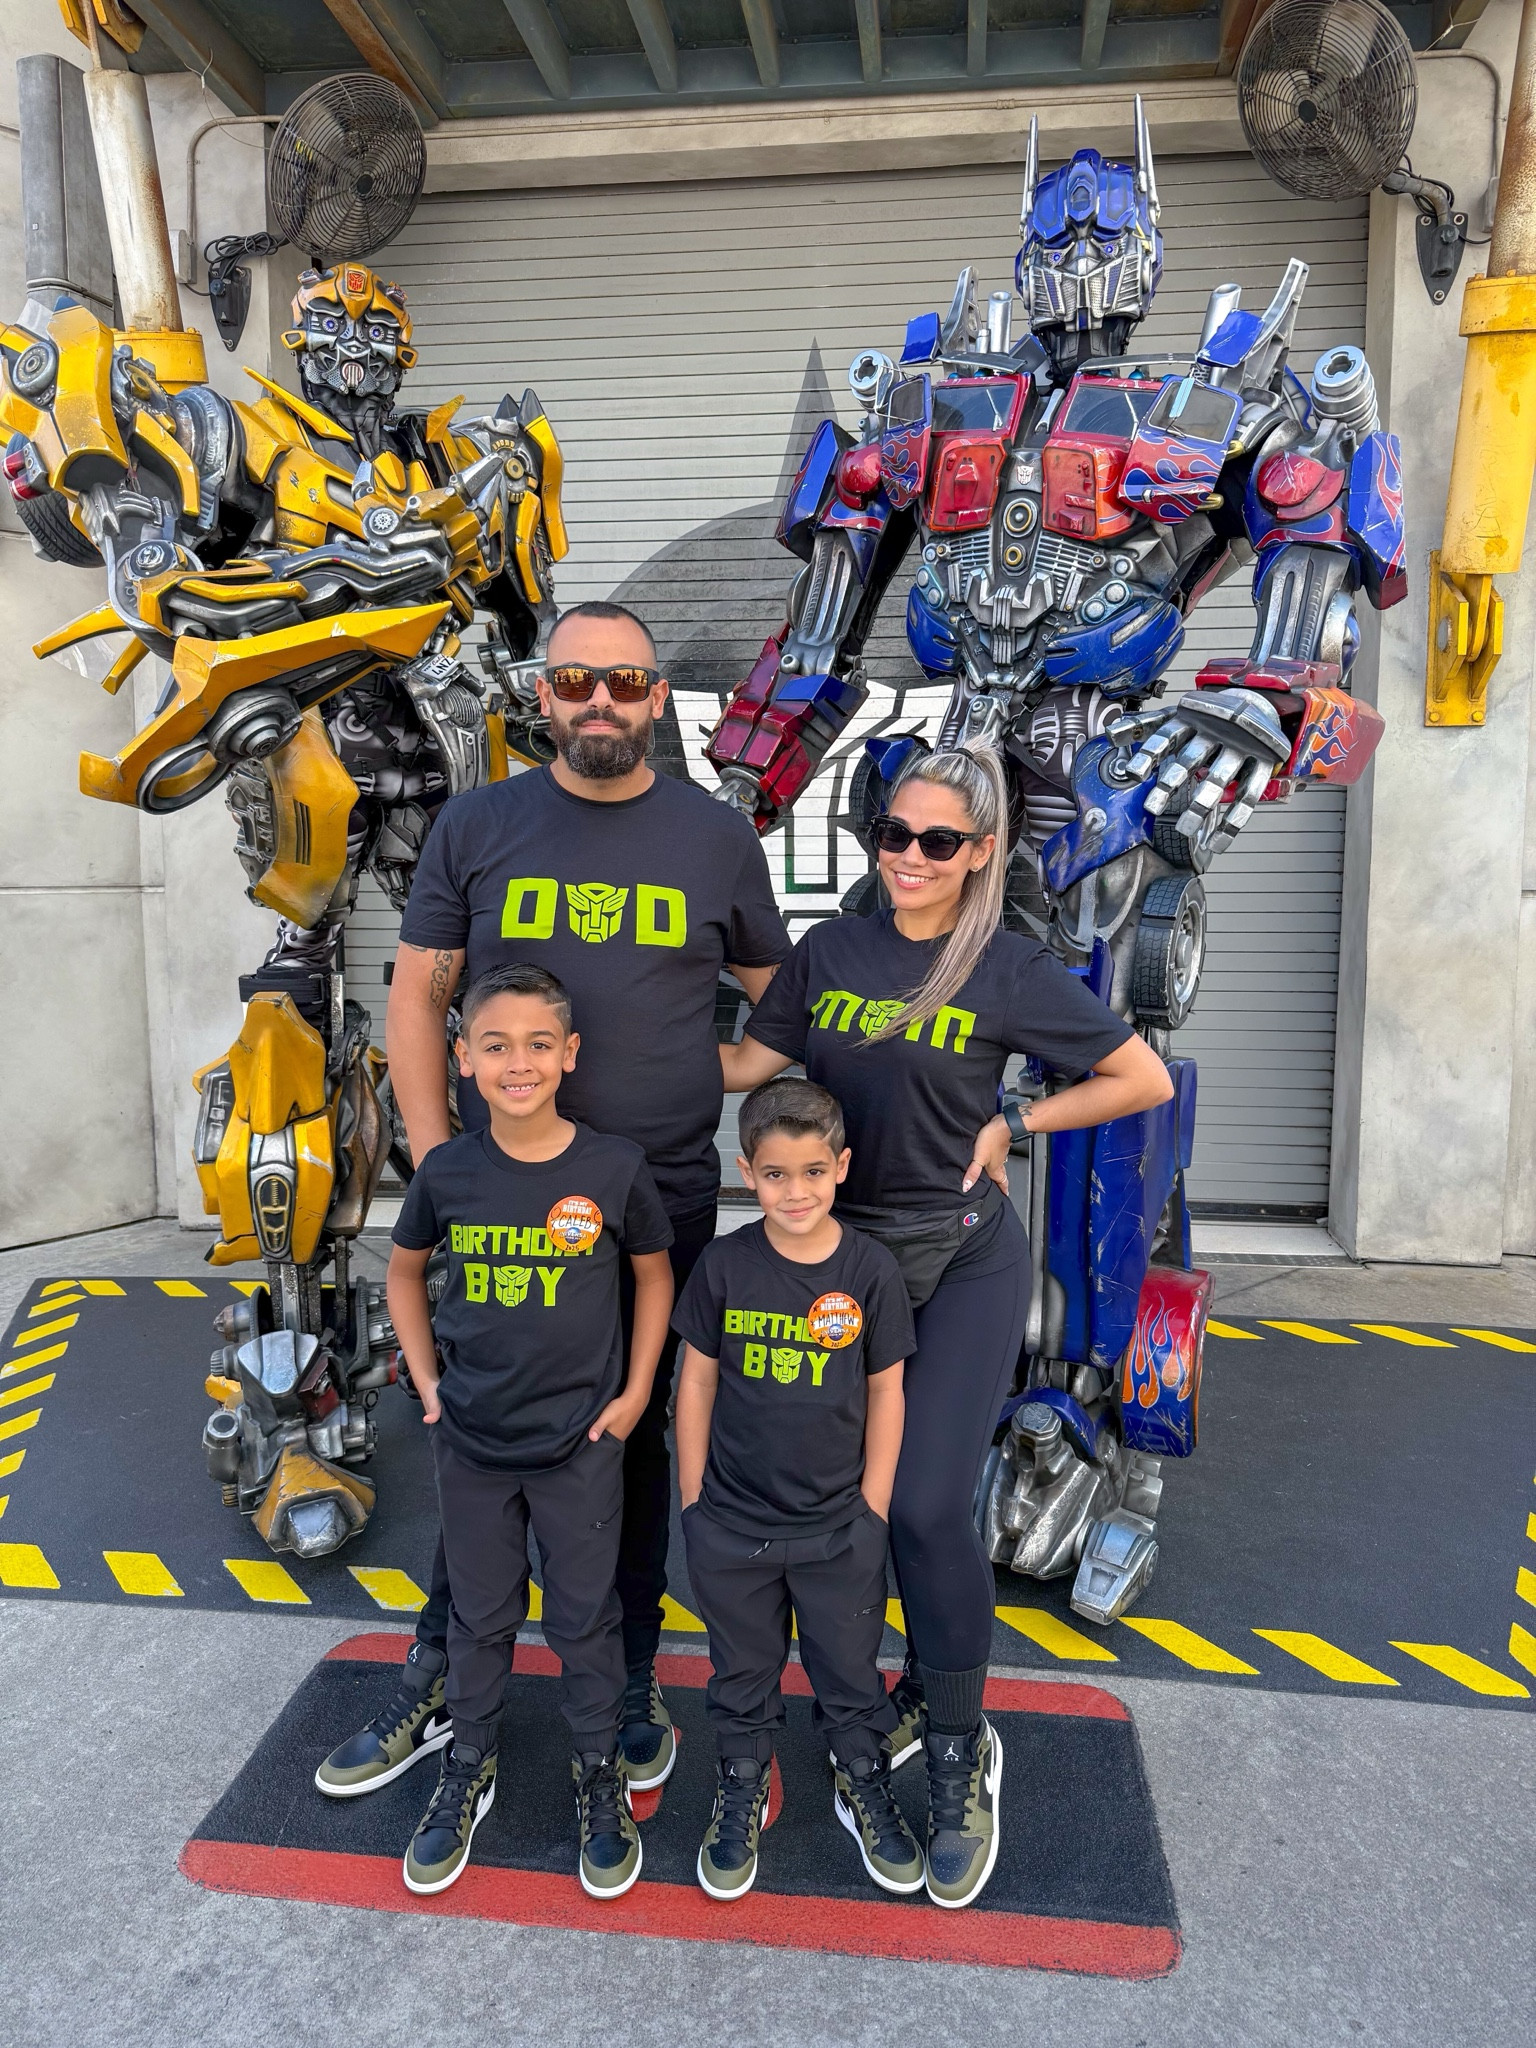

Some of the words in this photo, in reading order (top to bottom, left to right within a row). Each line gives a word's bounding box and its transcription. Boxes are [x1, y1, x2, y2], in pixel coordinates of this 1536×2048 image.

[562, 1204, 593, 1215] BIRTHDAY
[558, 1214, 592, 1229] CALEB
[450, 1224, 594, 1257] BIRTHD
[820, 1301, 850, 1311] BIRTHDAY
[818, 1312, 855, 1328] MATTHEW
